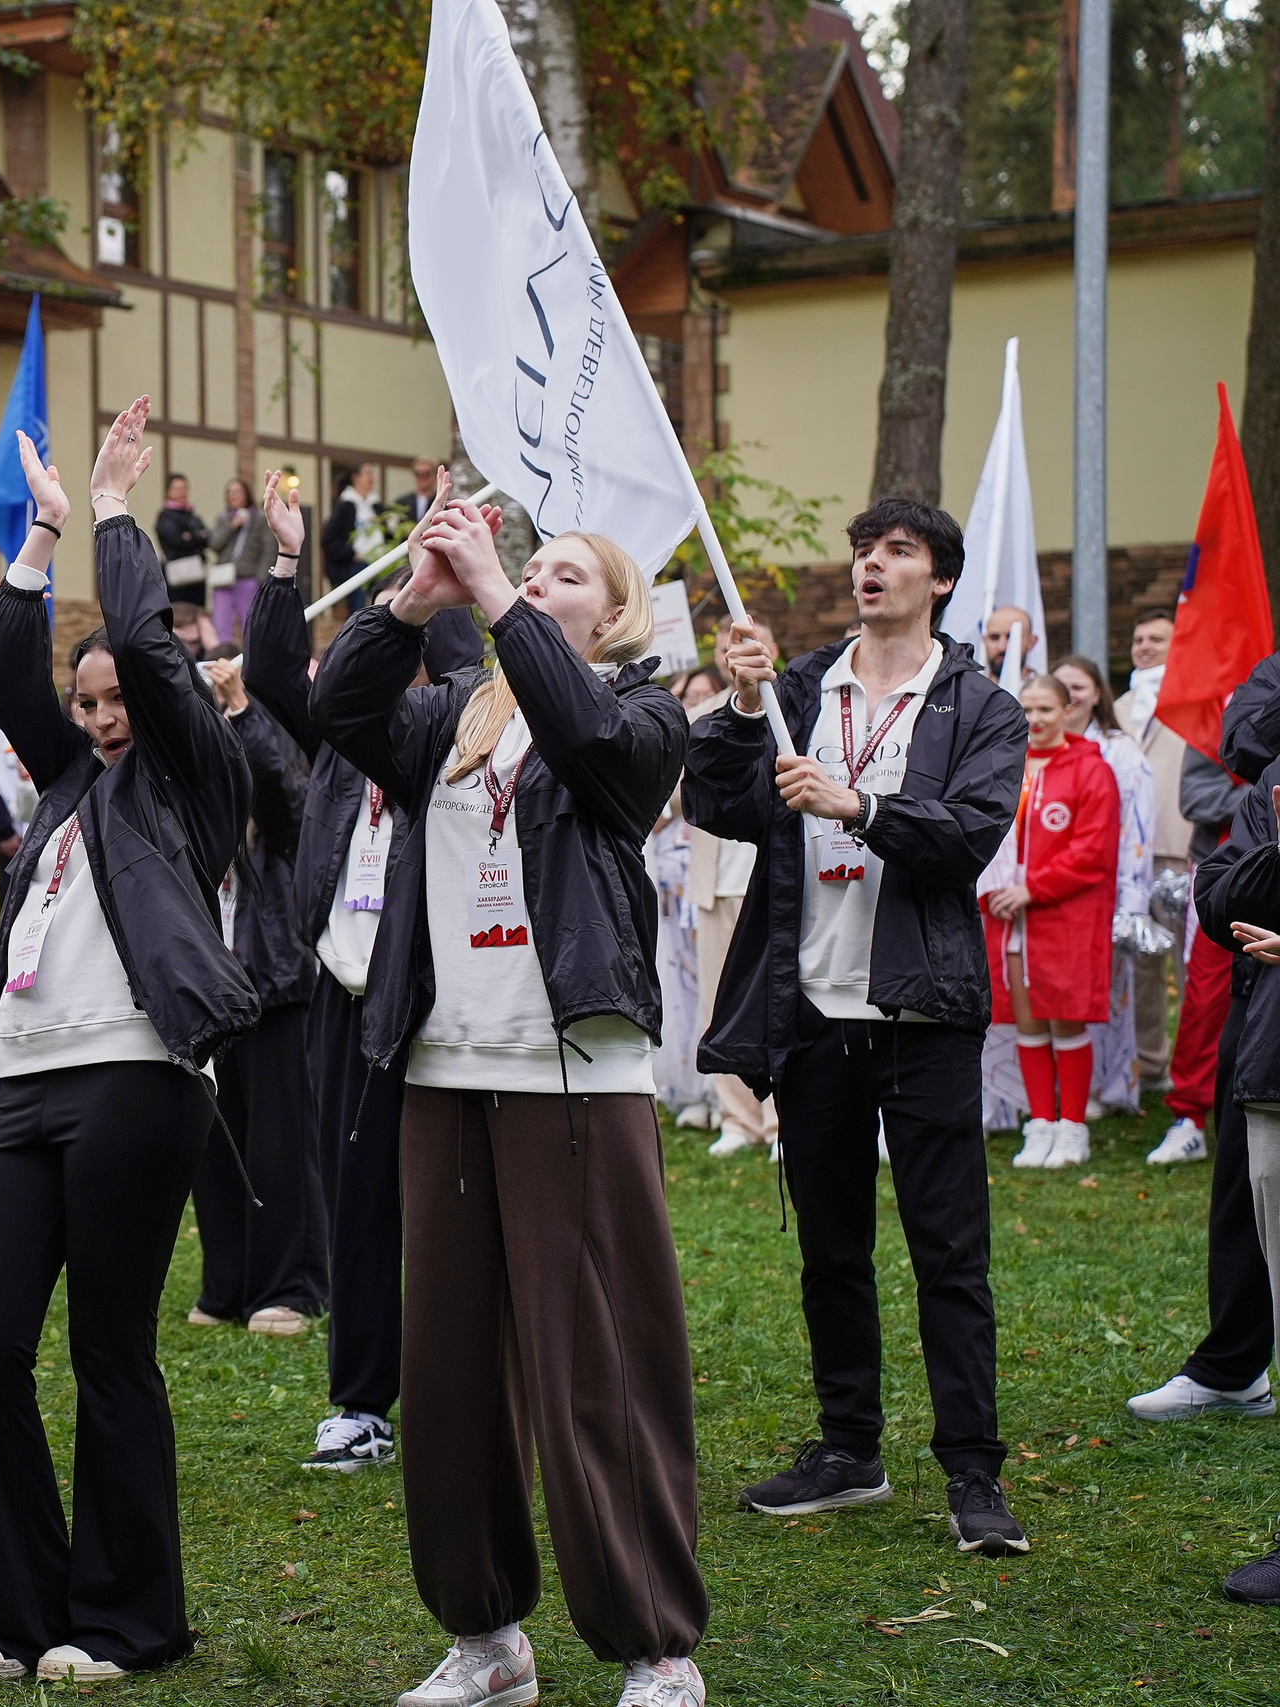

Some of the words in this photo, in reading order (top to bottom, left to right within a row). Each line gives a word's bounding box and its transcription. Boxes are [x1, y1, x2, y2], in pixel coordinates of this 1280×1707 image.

[862, 729, 882, 763] ФУНДАМЕНТ
[881, 709, 899, 732] ГОРОДА
[500, 783, 514, 813] ГОРОДА
[431, 799, 478, 813] АВТОРСКИЙ
[360, 855, 381, 863] XVIII
[480, 870, 508, 882] XVIII
